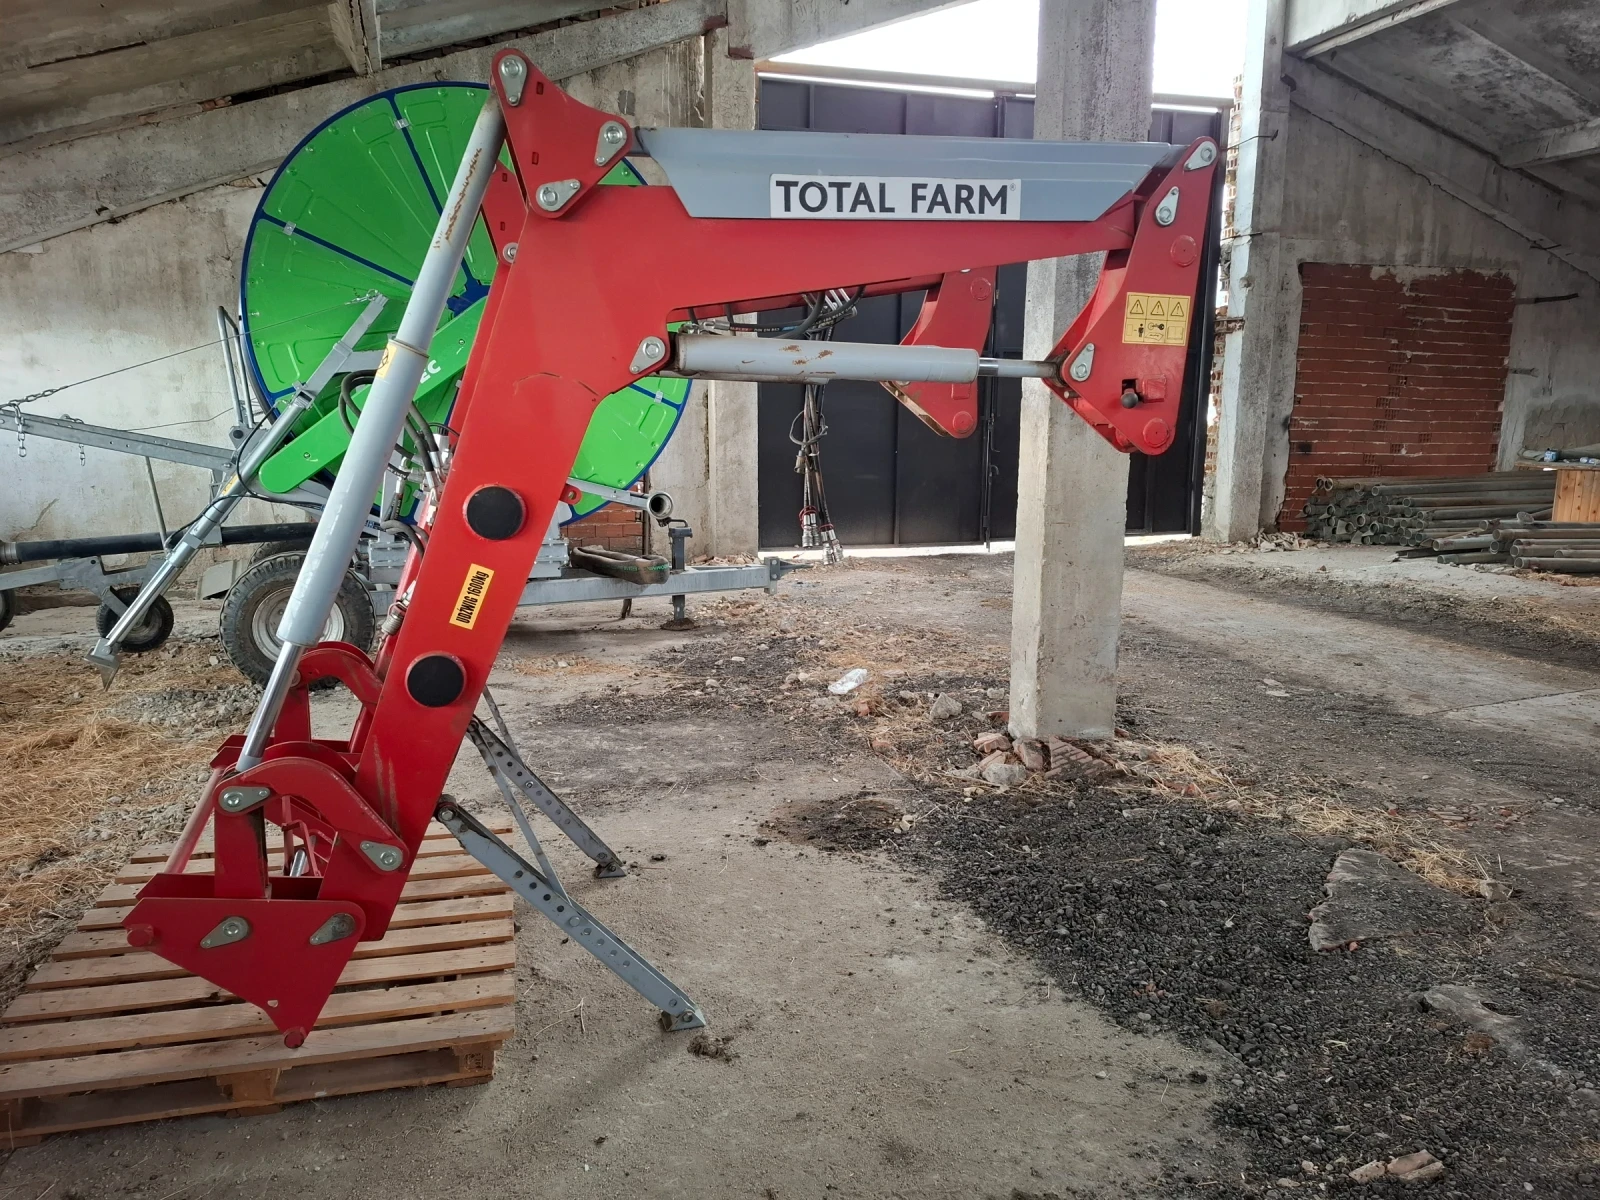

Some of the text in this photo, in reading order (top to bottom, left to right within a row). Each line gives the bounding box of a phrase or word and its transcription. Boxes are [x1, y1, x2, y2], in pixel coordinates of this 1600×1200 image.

[775, 180, 896, 213] TOTAL
[456, 570, 490, 624] UDŹWIG 1600kg
